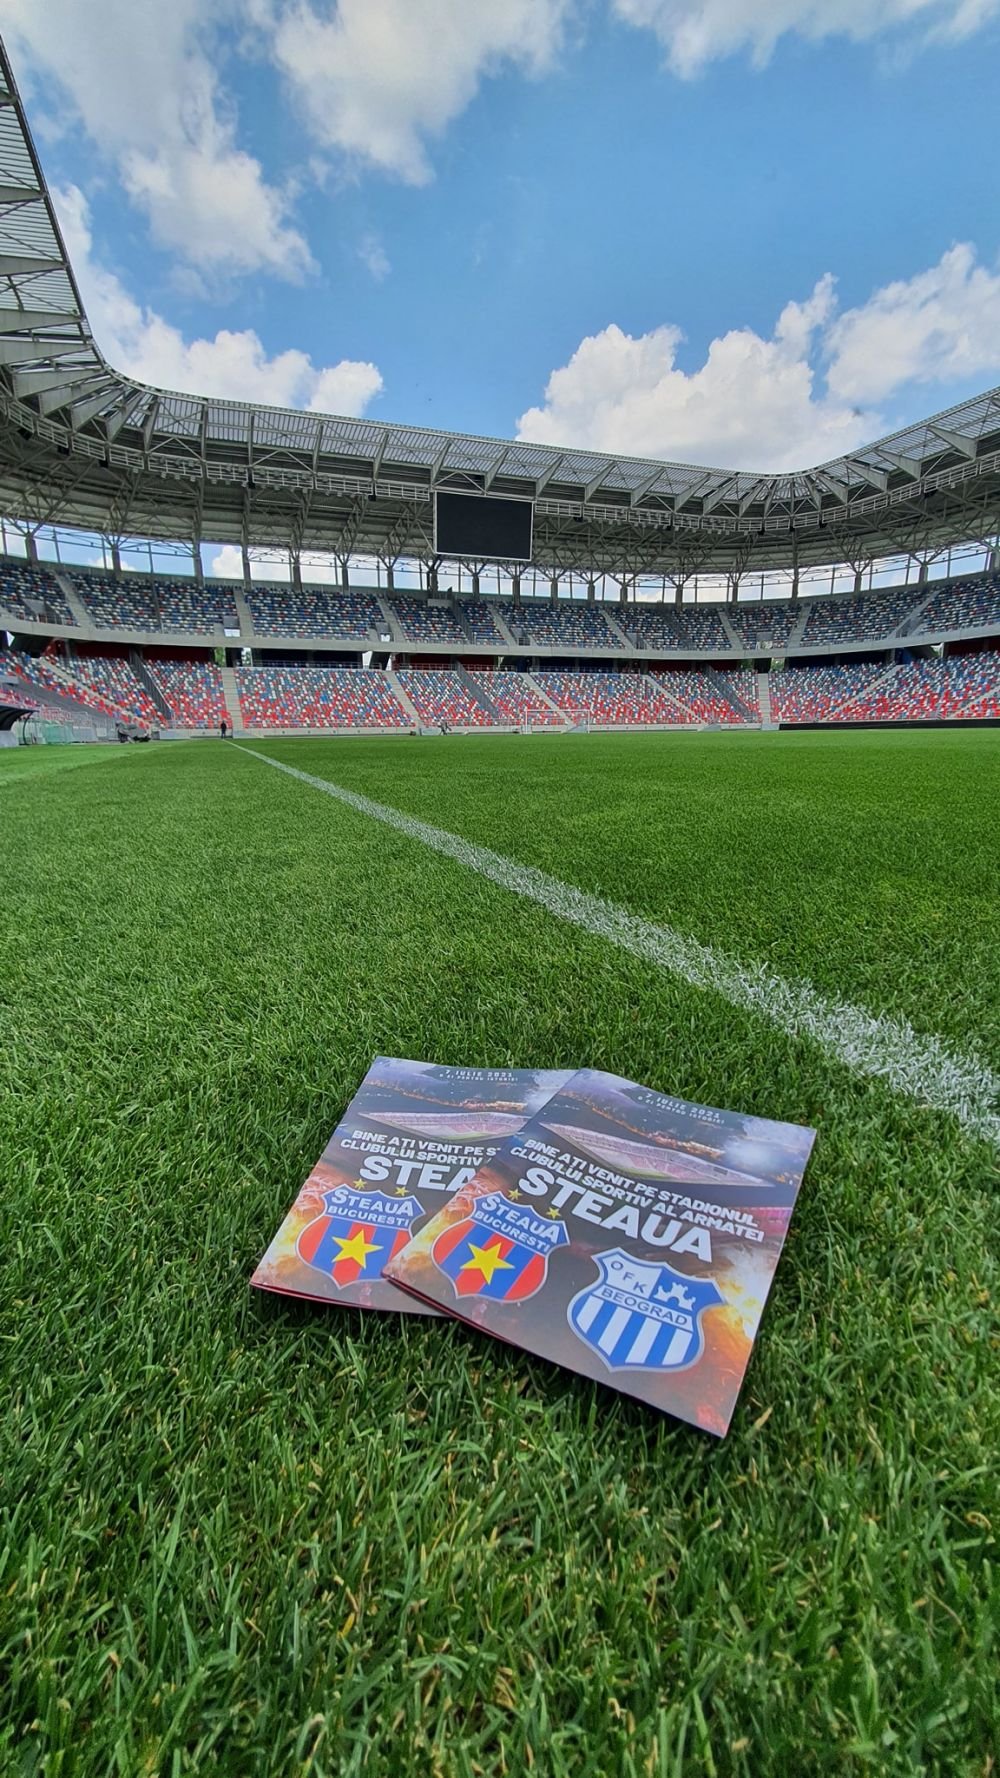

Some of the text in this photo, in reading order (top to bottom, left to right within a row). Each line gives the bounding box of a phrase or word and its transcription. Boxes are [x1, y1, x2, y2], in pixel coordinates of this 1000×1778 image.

[656, 1097, 687, 1110] IULIE
[691, 1107, 720, 1119] 2021
[340, 1138, 416, 1159] CLUBULUI
[416, 1151, 483, 1166] SPORTIV
[352, 1130, 388, 1143] BINE
[418, 1141, 463, 1155] VENIT
[464, 1146, 485, 1155] PE
[359, 1155, 477, 1192] STEA
[524, 1139, 560, 1158] BINE
[588, 1163, 635, 1189] VENIT
[634, 1182, 659, 1198] PE
[657, 1191, 759, 1228] STADIONUL
[331, 1188, 414, 1217] STEAUA
[510, 1146, 765, 1243] CLUBULUI SPORTIV AL ARMATEI
[327, 1205, 409, 1227] BUCURESTI
[473, 1210, 551, 1253] BUCURESTI
[481, 1195, 560, 1244] STEAUA
[518, 1167, 713, 1264] STEAUA
[600, 1286, 688, 1326] BEOGRAD
